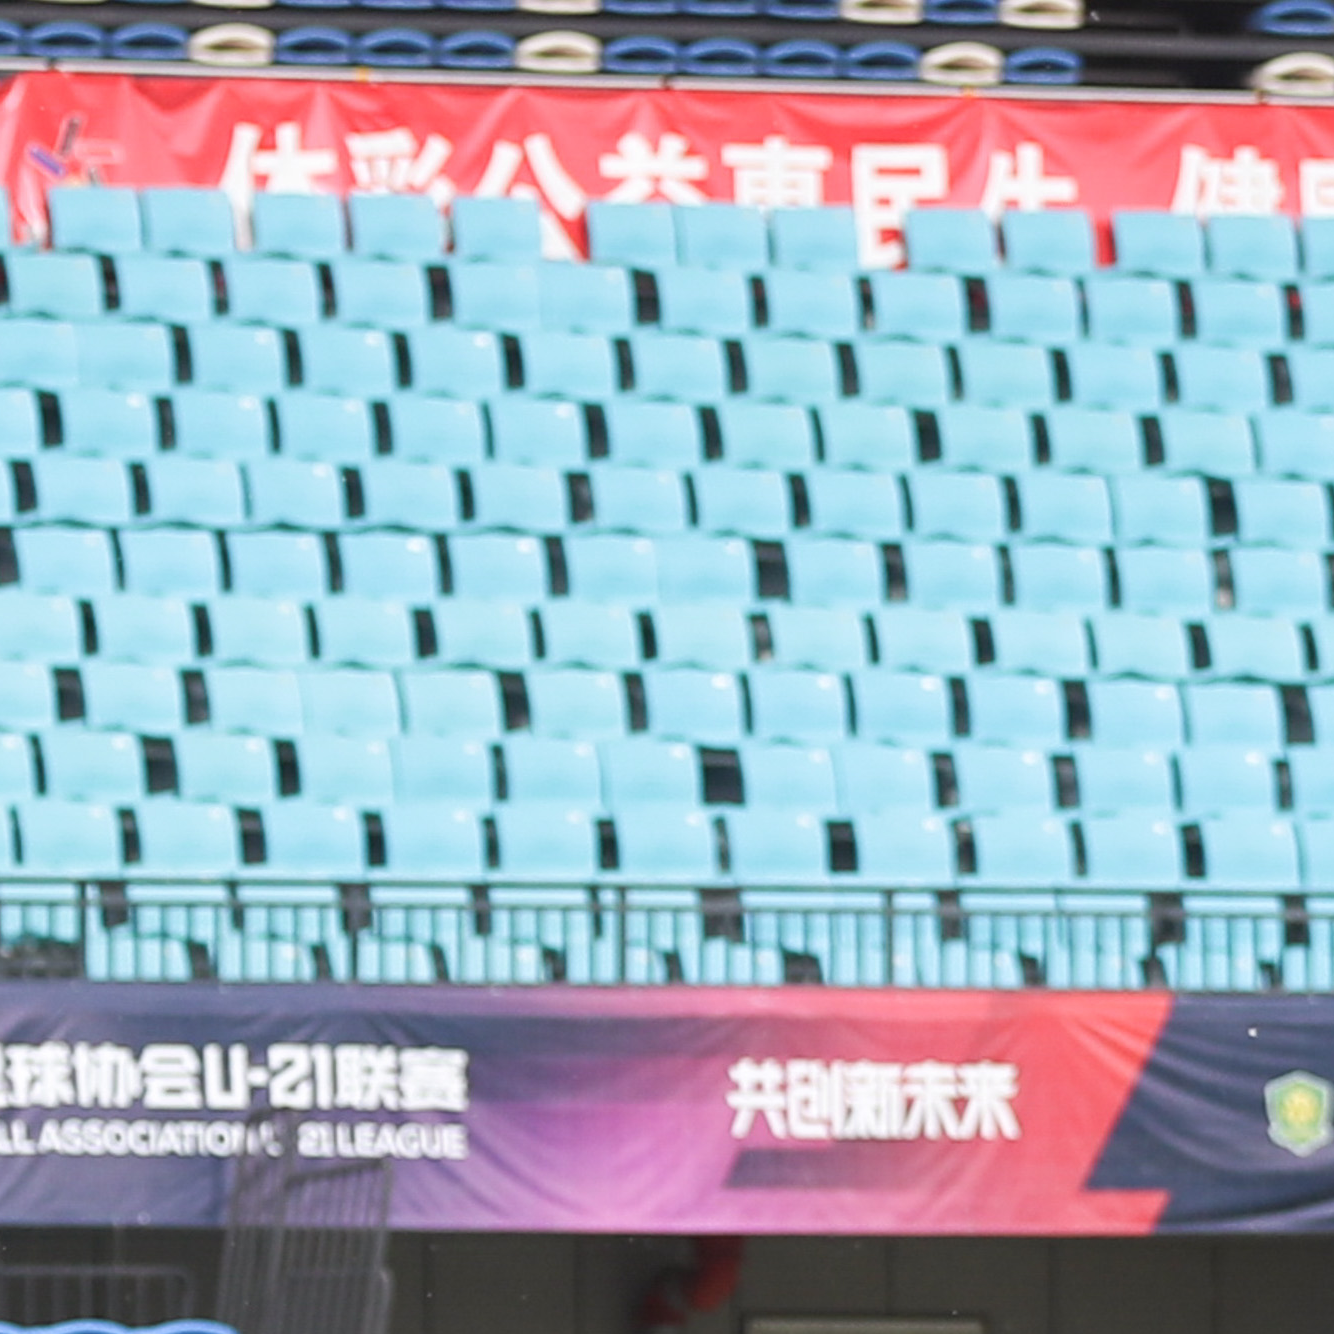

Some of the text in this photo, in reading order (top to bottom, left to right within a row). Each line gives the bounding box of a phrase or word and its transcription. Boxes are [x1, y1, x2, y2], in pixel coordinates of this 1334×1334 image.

[726, 1057, 1021, 1140] 共创新未来
[336, 1121, 467, 1159] LEAGUE
